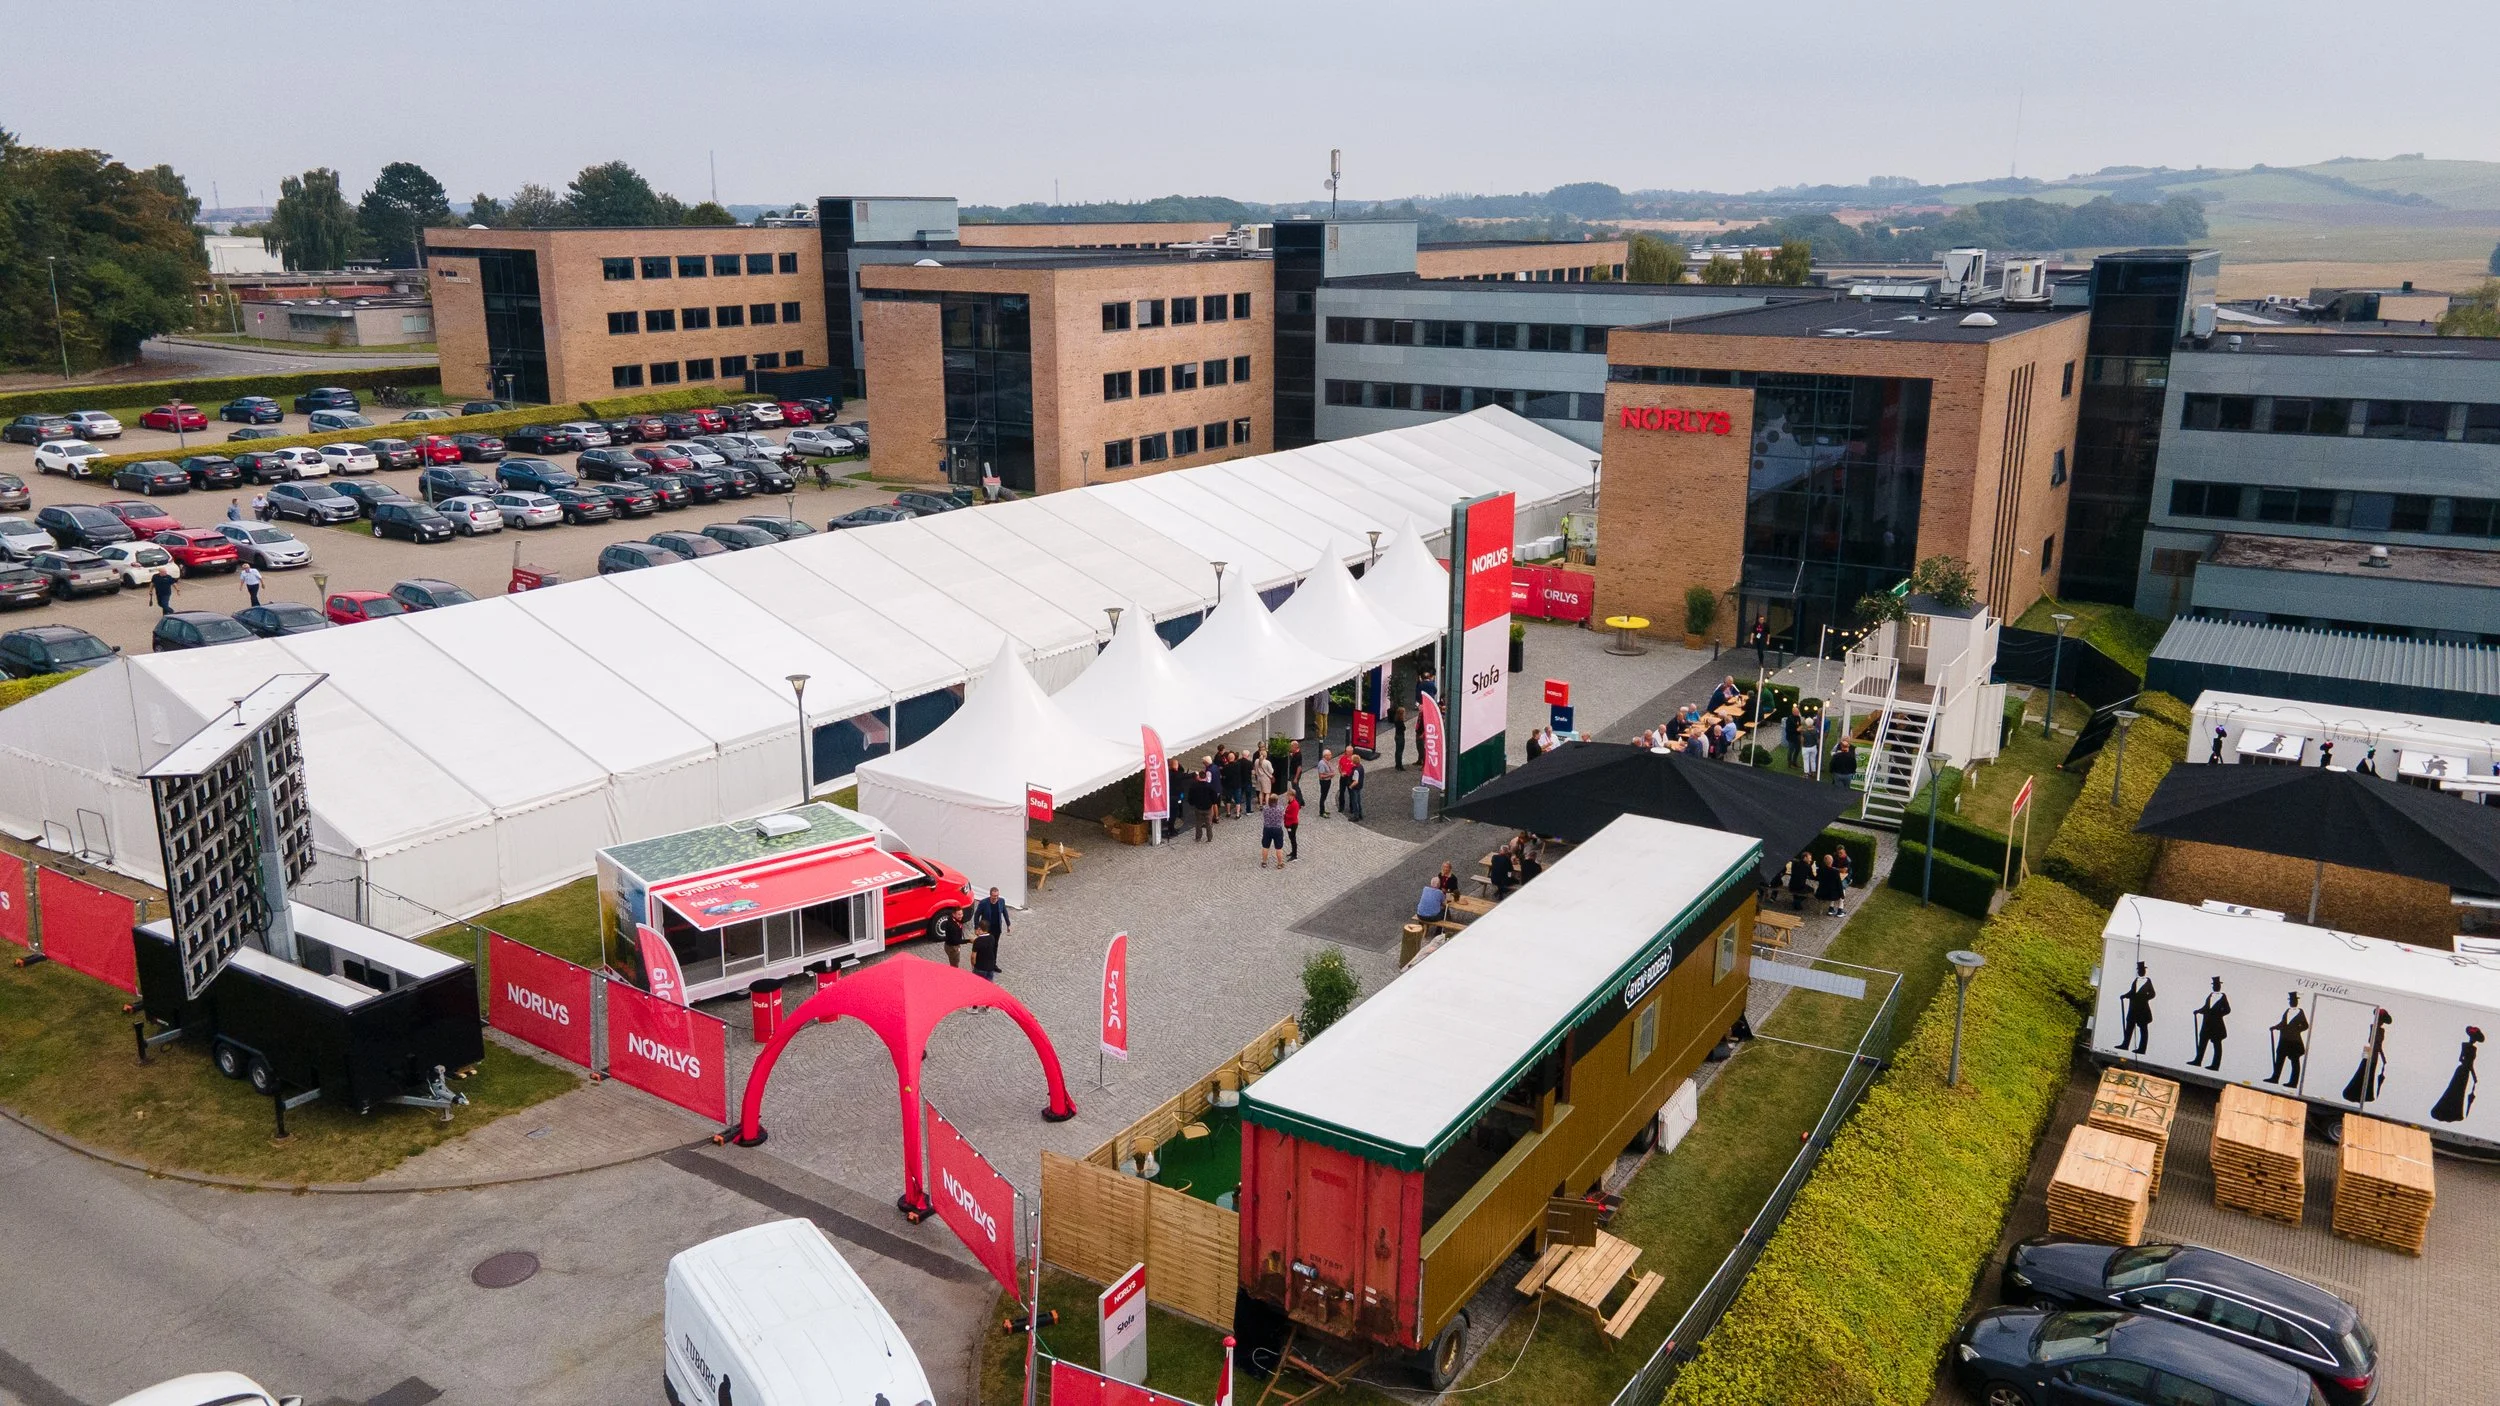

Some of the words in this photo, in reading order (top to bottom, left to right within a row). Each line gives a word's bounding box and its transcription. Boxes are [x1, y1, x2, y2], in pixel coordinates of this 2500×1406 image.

[1620, 405, 1732, 435] NORLYS
[1471, 546, 1508, 575] NORLYS
[1471, 664, 1500, 694] Stofa
[1029, 796, 1049, 810] Stofa
[675, 878, 743, 897] Lynhurtig
[739, 882, 760, 890] og
[851, 870, 904, 888] Stofa
[2295, 978, 2319, 989] VIP
[2319, 983, 2349, 995] Toilet
[507, 982, 570, 1026] NORLYS
[628, 1032, 701, 1078] NORLYS
[942, 1166, 997, 1243] NORLYS
[1113, 1279, 1137, 1304] NORLYS
[1116, 1313, 1136, 1335] Stofa
[685, 1332, 717, 1394] TUBORG
